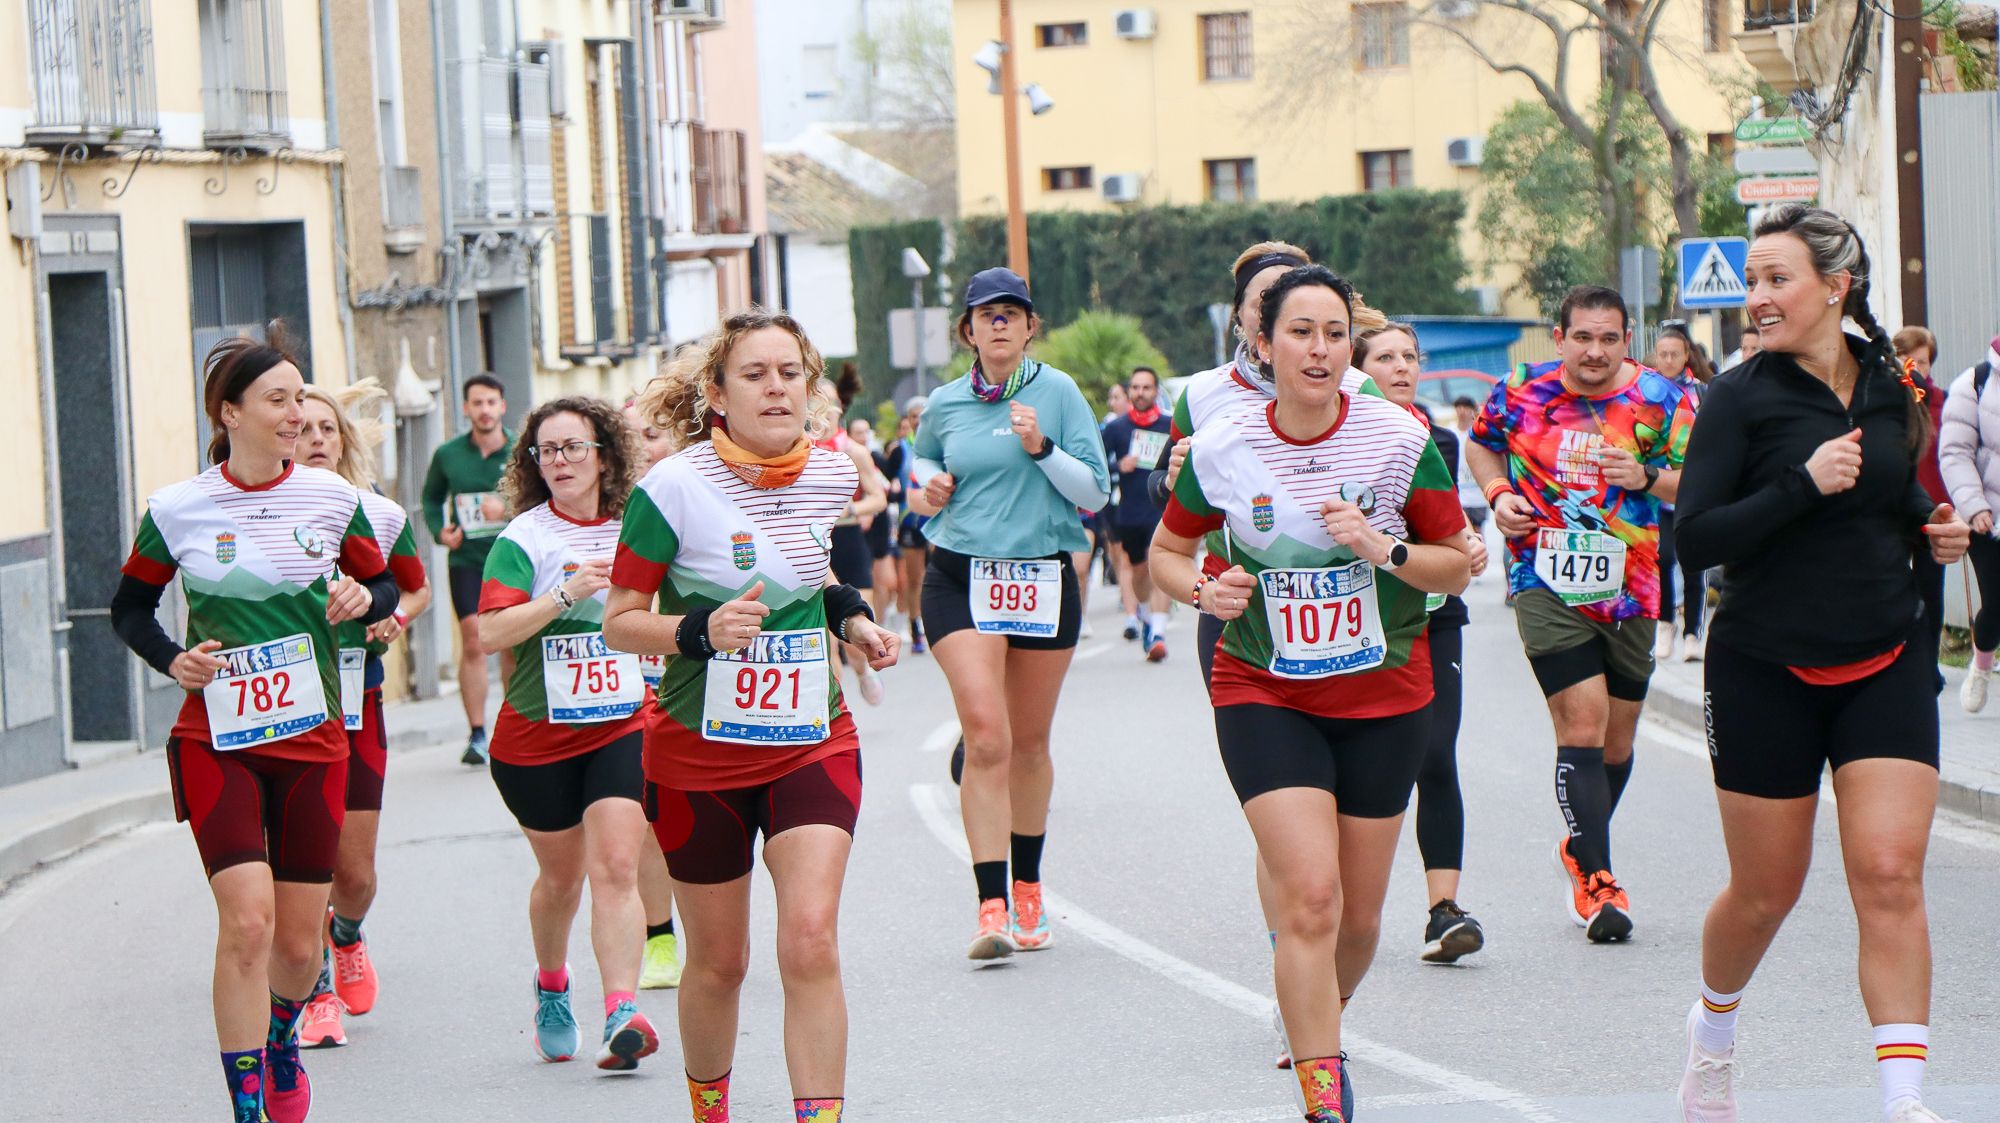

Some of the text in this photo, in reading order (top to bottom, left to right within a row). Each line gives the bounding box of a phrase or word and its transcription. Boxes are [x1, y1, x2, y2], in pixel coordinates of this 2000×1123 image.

[1744, 182, 1784, 196] Ciudad
[1293, 465, 1331, 475] TEAMERGY
[762, 508, 797, 517] TEAMERGY
[1546, 532, 1570, 551] 10K
[984, 561, 1012, 579] 21K
[1549, 553, 1610, 582] 1479
[989, 583, 1038, 612] 993
[1278, 572, 1315, 599] 21K
[1279, 597, 1362, 645] 1079
[558, 639, 590, 659] 21K
[219, 650, 253, 679] 21K
[567, 660, 620, 695] 755
[230, 671, 295, 717] 782
[735, 667, 801, 710] 921
[1704, 691, 1718, 757] WONG
